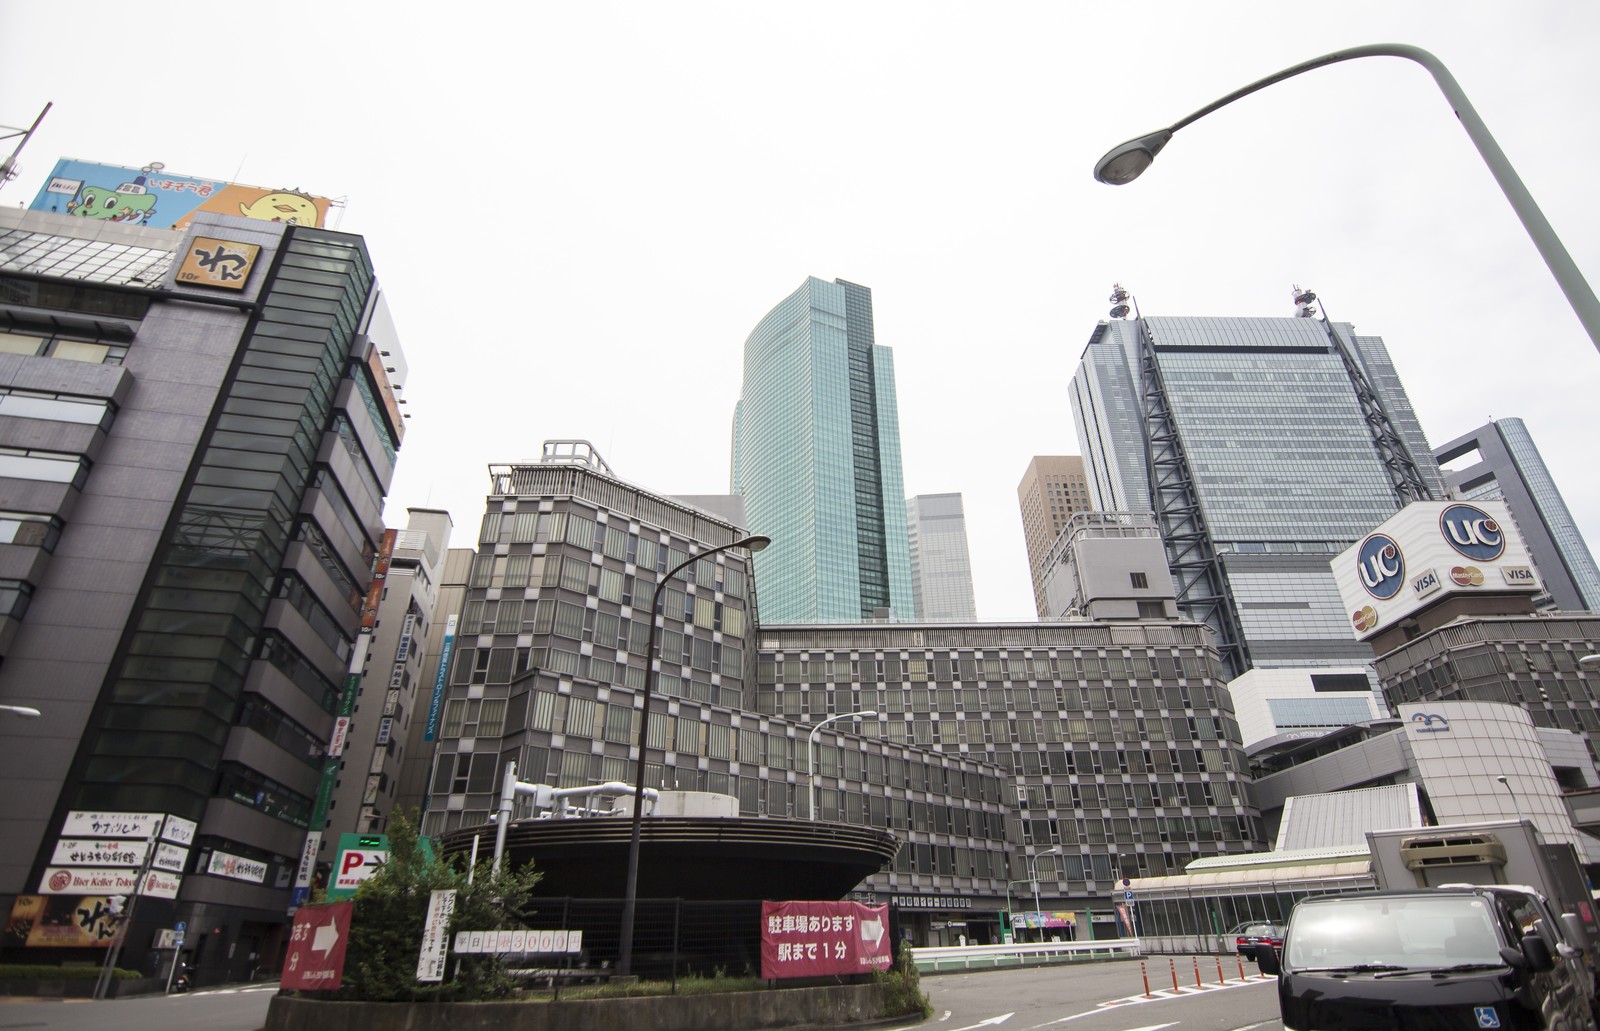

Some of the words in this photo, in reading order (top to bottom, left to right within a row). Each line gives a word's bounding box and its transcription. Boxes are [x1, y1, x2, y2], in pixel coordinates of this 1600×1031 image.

[195, 246, 247, 280] わん
[181, 272, 200, 280] 10F
[1446, 518, 1500, 546] UC
[1360, 546, 1399, 587] UC
[1507, 570, 1534, 579] VISA
[1414, 573, 1436, 592] VISA
[341, 853, 365, 875] P
[768, 915, 855, 934] 駐車場あります
[778, 941, 847, 961] 駅まで1分
